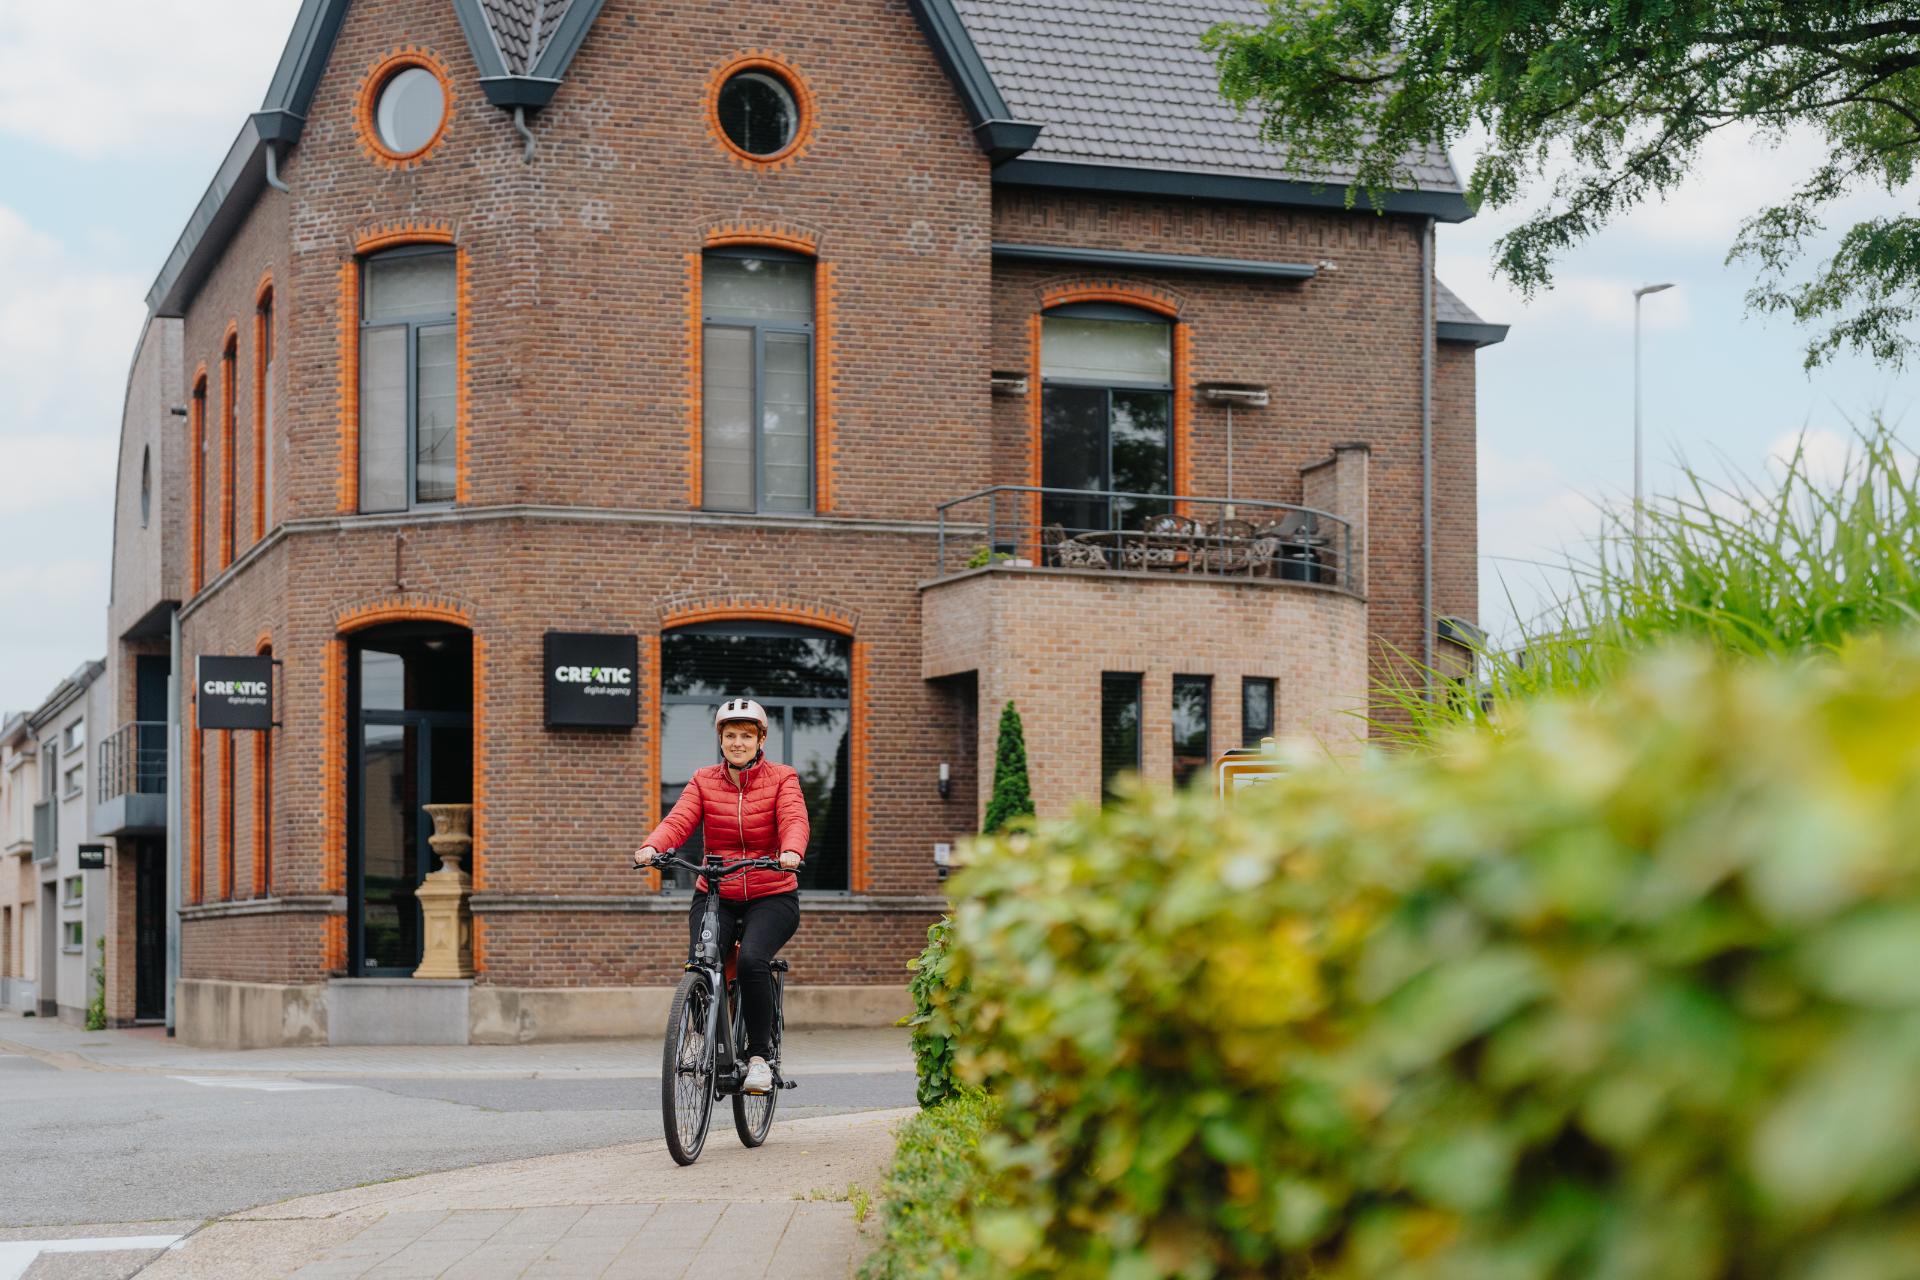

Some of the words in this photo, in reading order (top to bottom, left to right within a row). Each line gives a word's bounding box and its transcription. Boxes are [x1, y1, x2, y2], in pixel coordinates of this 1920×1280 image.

[555, 666, 631, 684] CREATIC
[204, 680, 267, 695] CREATIC
[584, 686, 605, 695] digital
[606, 687, 631, 696] agency
